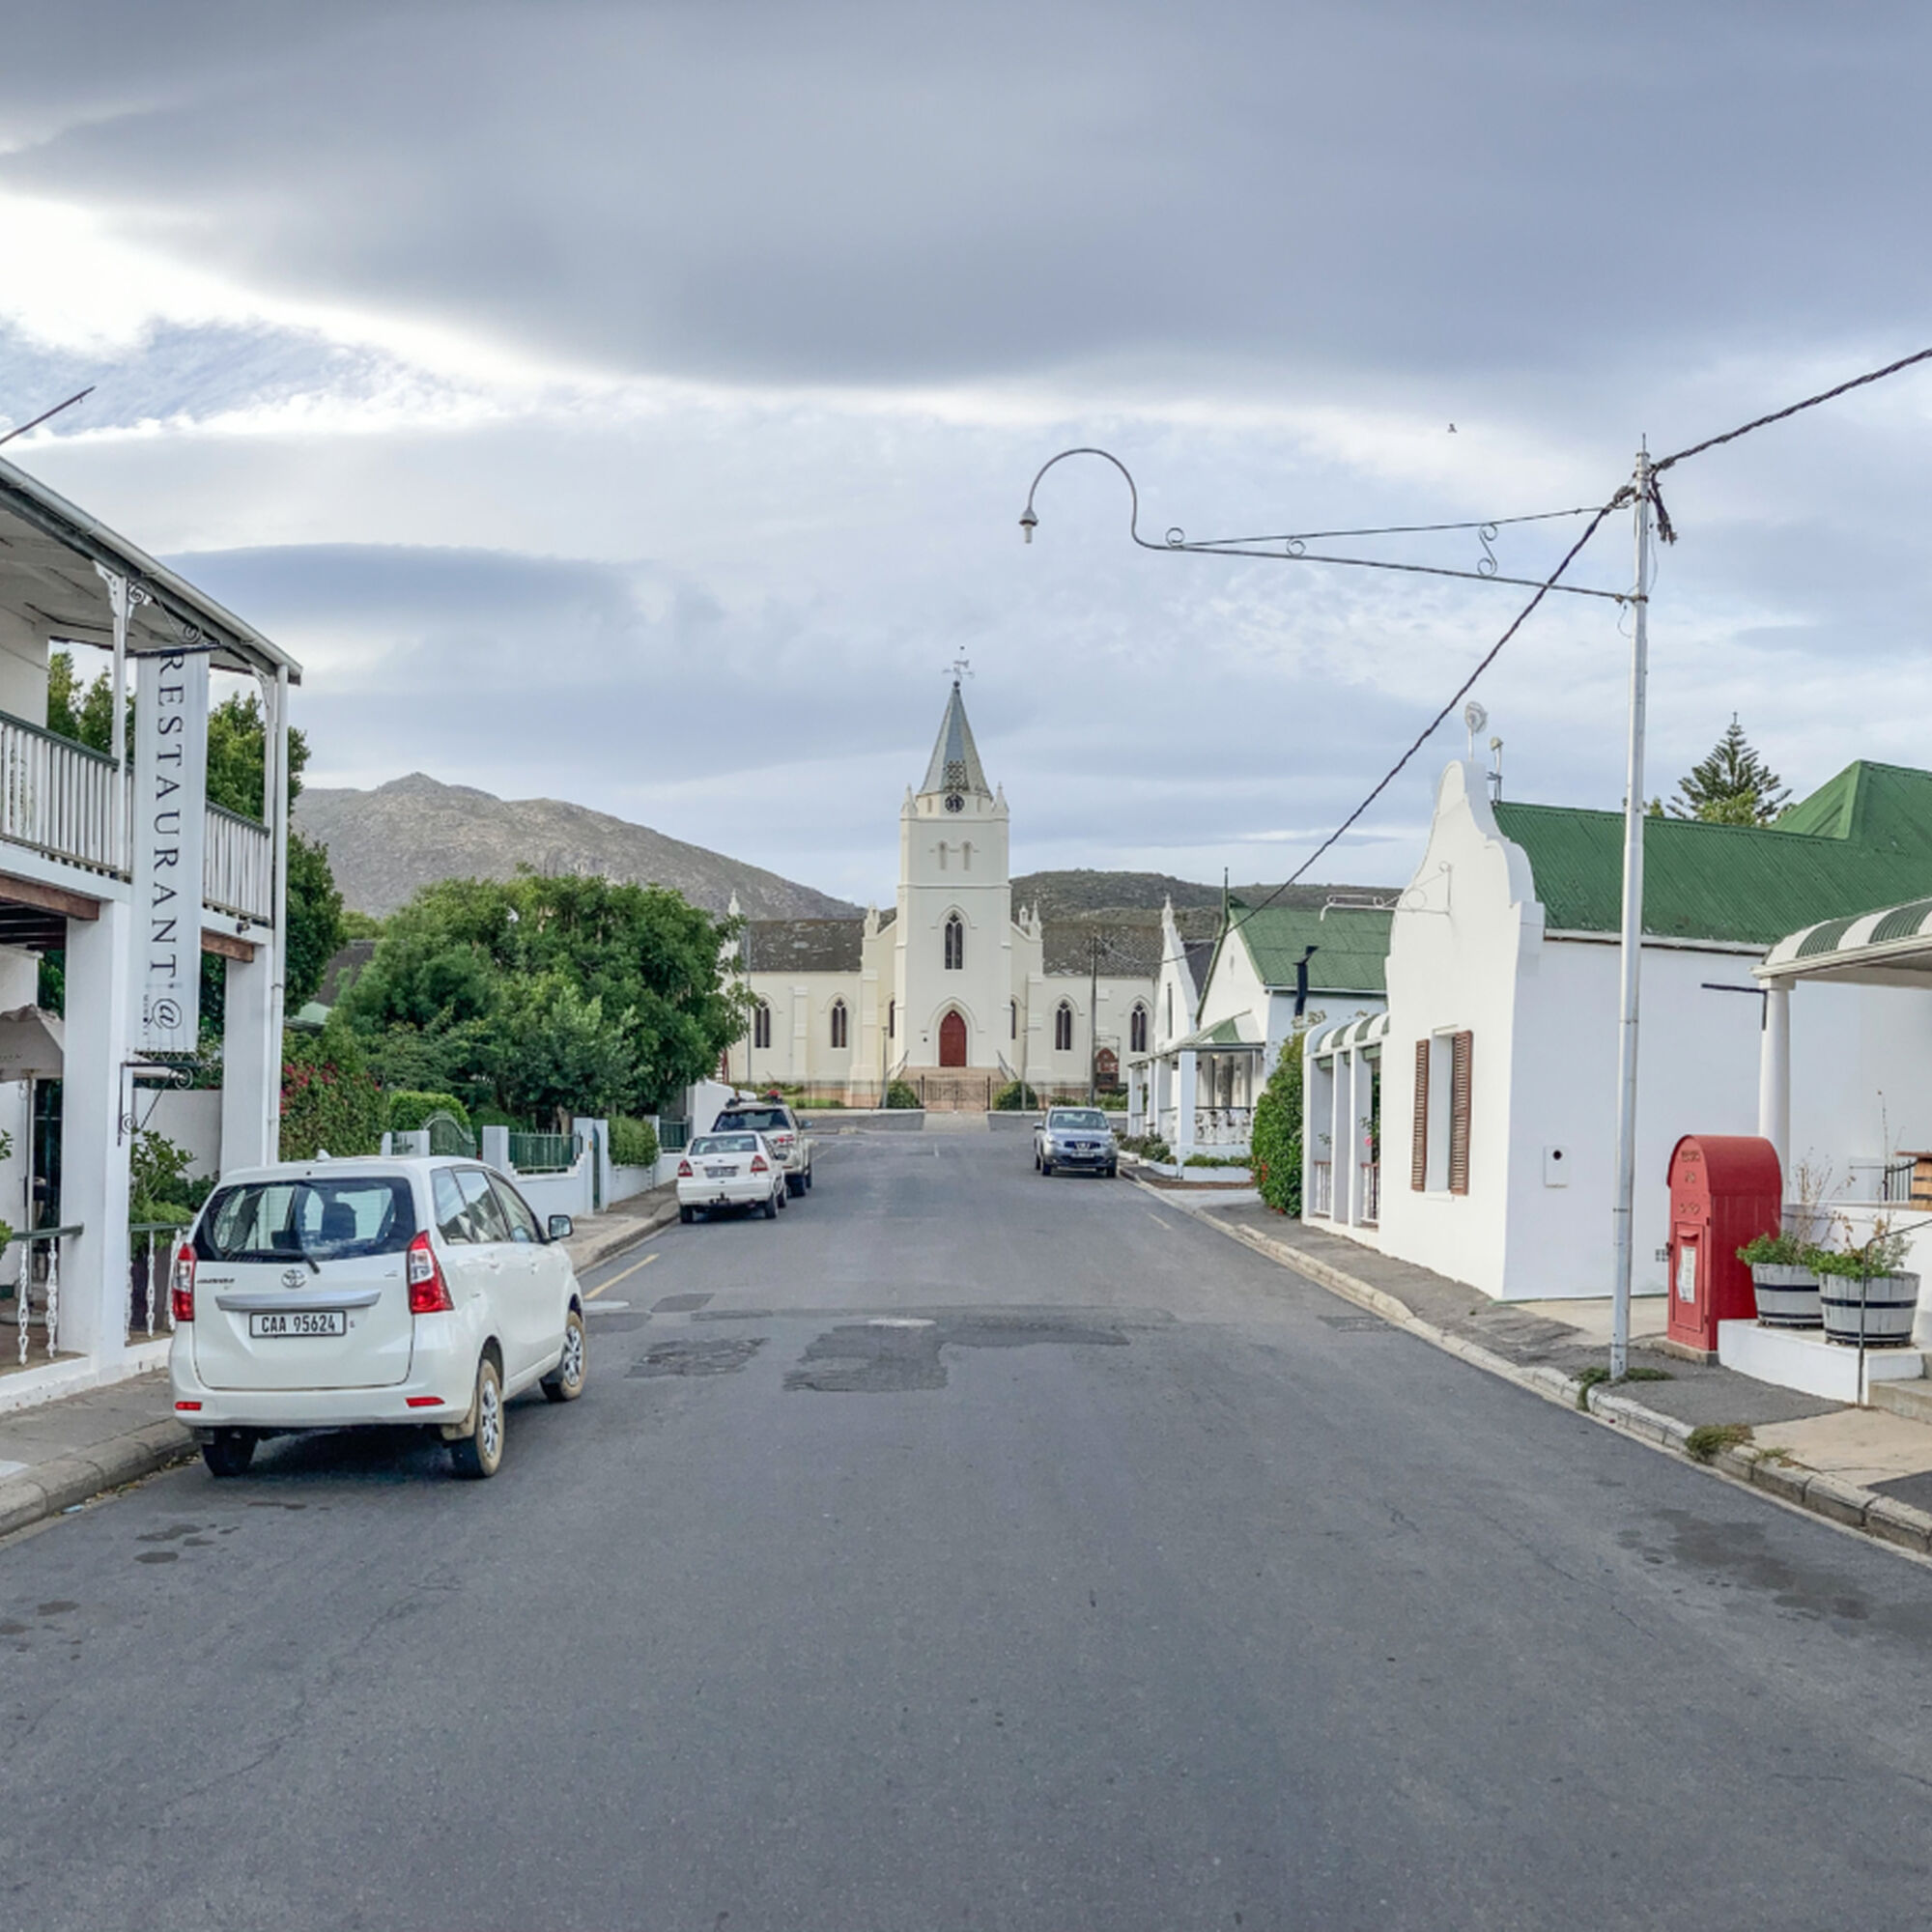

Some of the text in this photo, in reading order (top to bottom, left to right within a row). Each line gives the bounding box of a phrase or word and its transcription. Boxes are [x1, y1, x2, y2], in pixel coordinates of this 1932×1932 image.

[150, 653, 184, 978] RESTAURANT
[261, 1315, 335, 1333] CAA 95624
